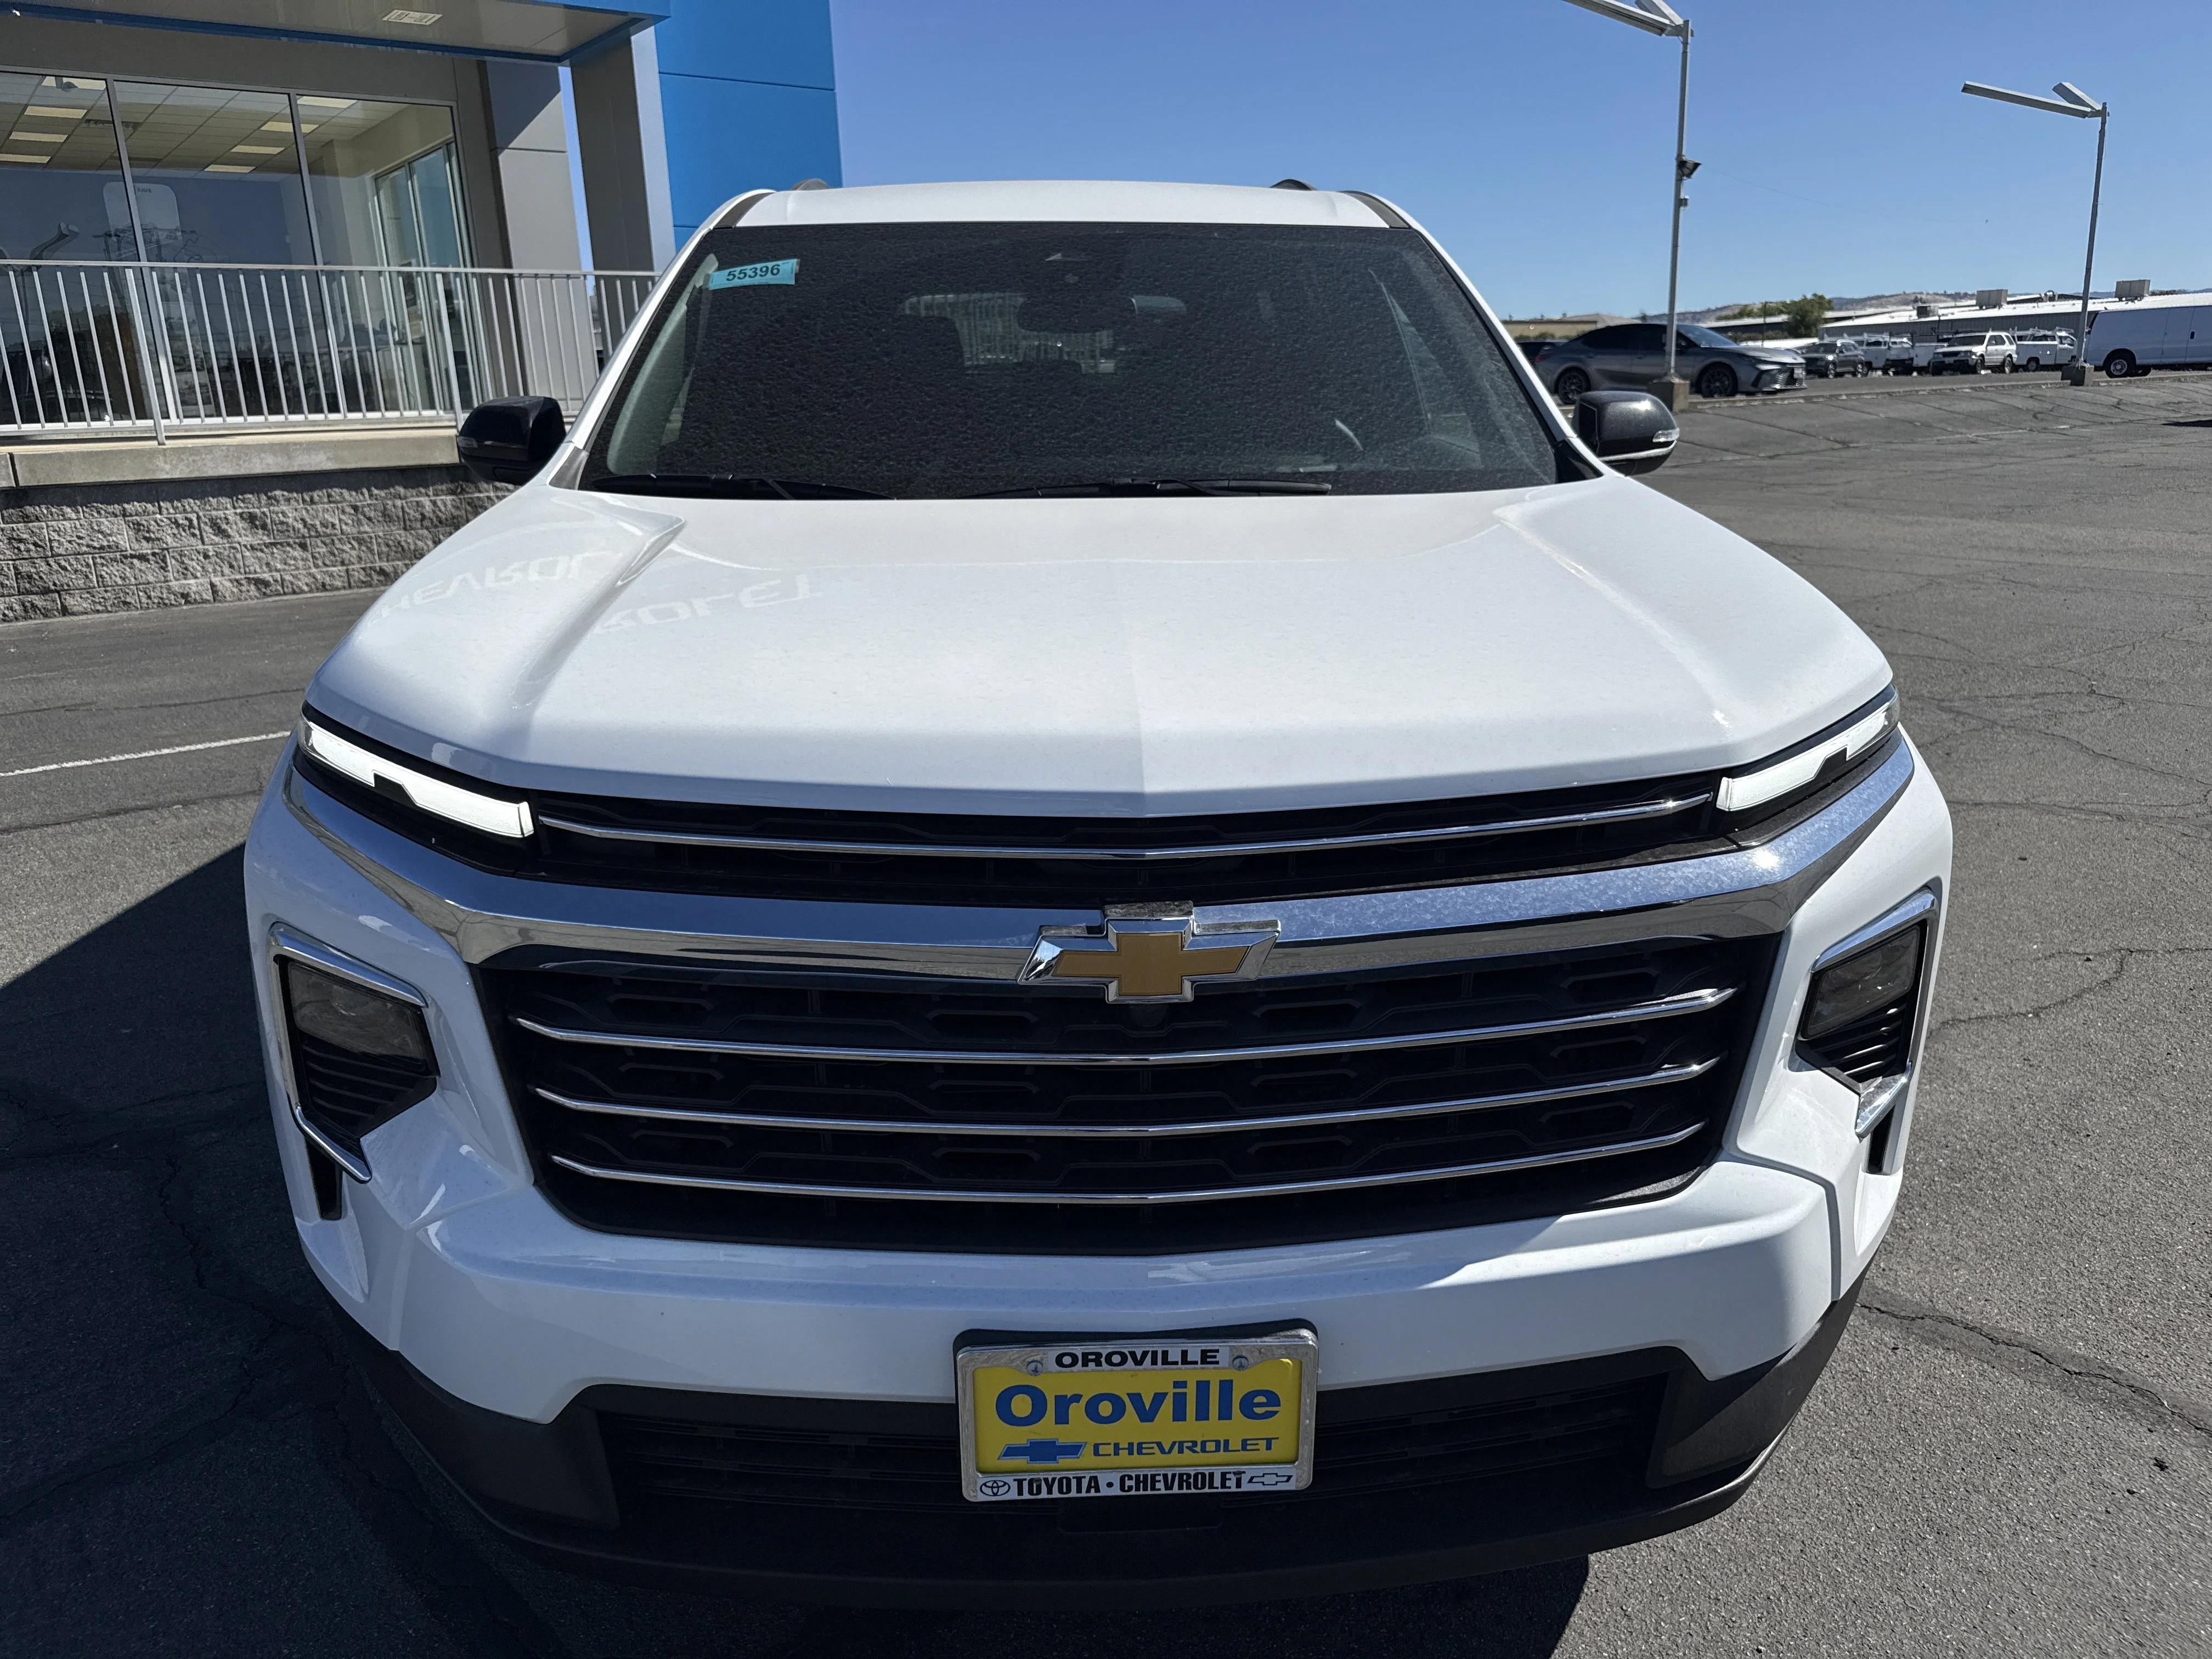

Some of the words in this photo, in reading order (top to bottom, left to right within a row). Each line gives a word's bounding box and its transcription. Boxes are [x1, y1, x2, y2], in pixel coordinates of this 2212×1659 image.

[726, 264, 781, 281] 55396
[1055, 1348, 1220, 1368] OROVILLE
[995, 1379, 1281, 1426] Oroville
[1093, 1437, 1279, 1457] CHEVROLET
[1013, 1474, 1101, 1497] TOYOTA
[1119, 1470, 1246, 1493] CHEVROLET
